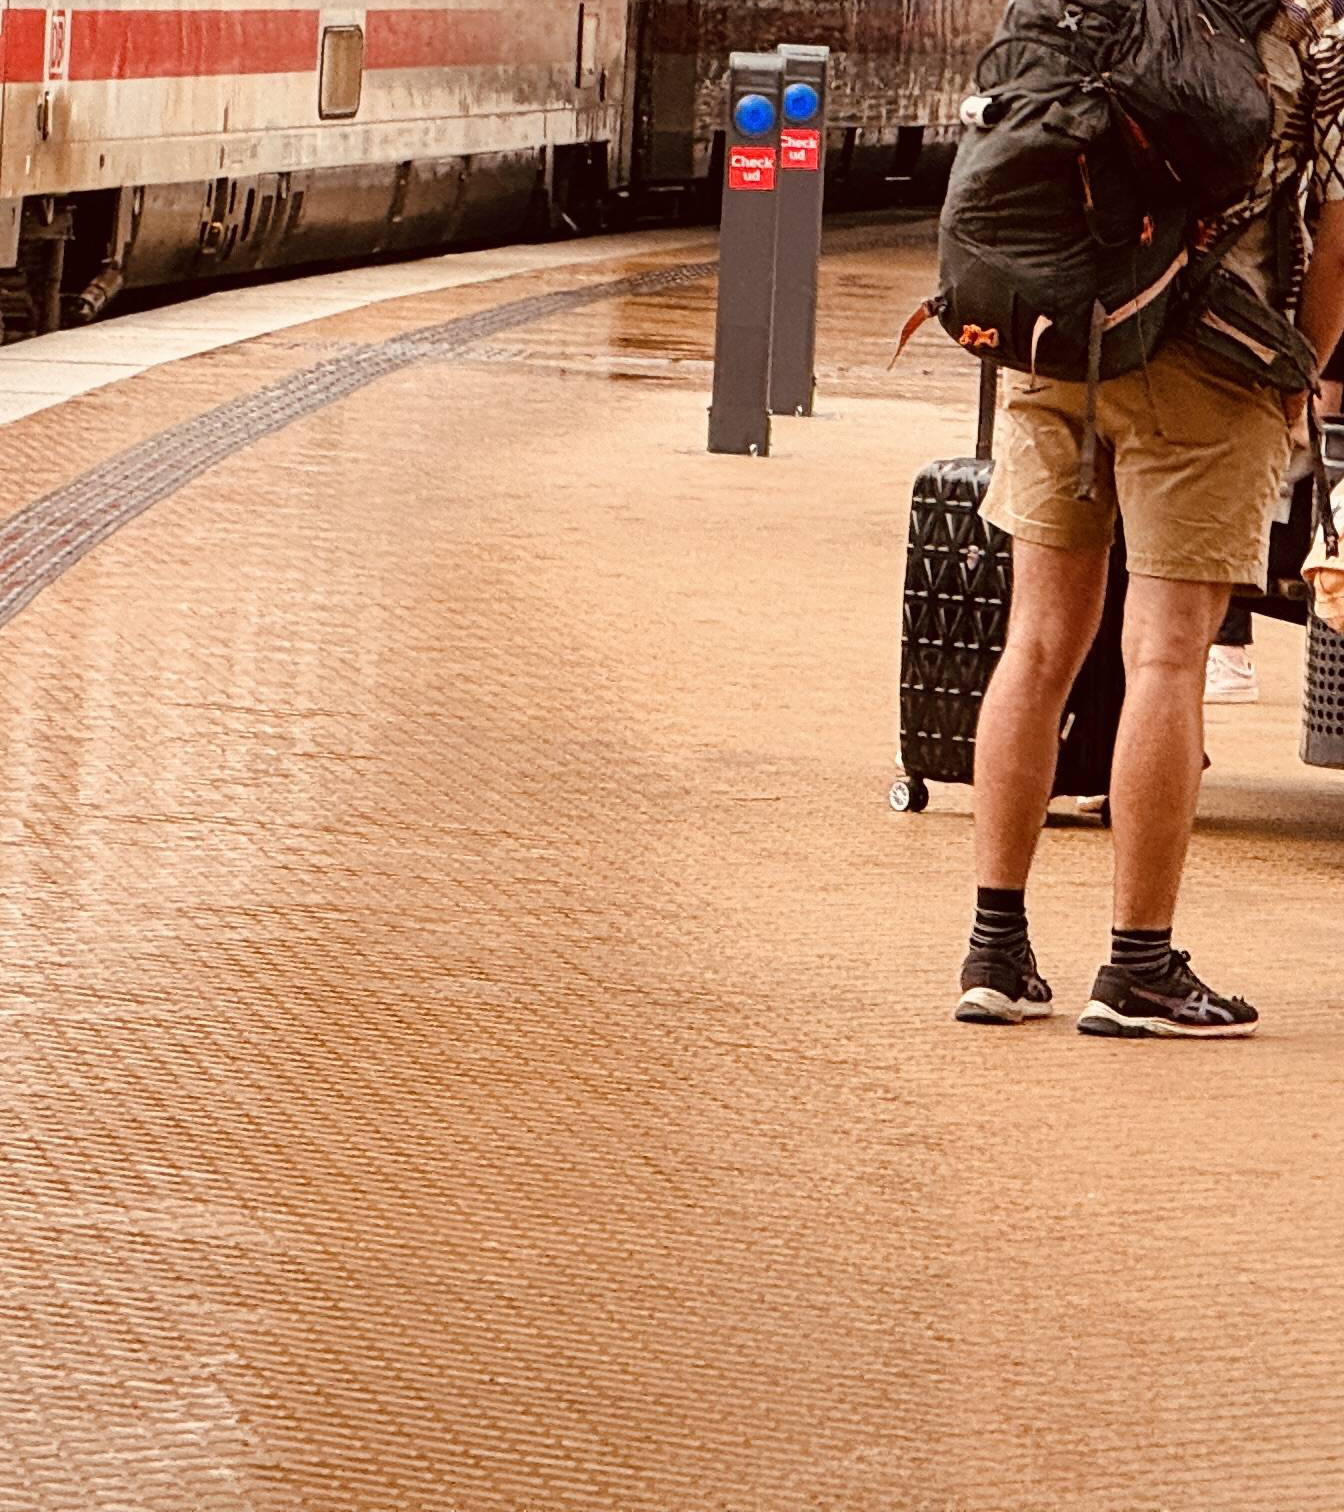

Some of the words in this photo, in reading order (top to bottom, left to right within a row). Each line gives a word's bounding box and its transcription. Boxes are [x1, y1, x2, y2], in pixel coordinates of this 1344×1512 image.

[789, 148, 806, 160] ud
[731, 155, 774, 168] Check
[743, 169, 761, 181] ud
